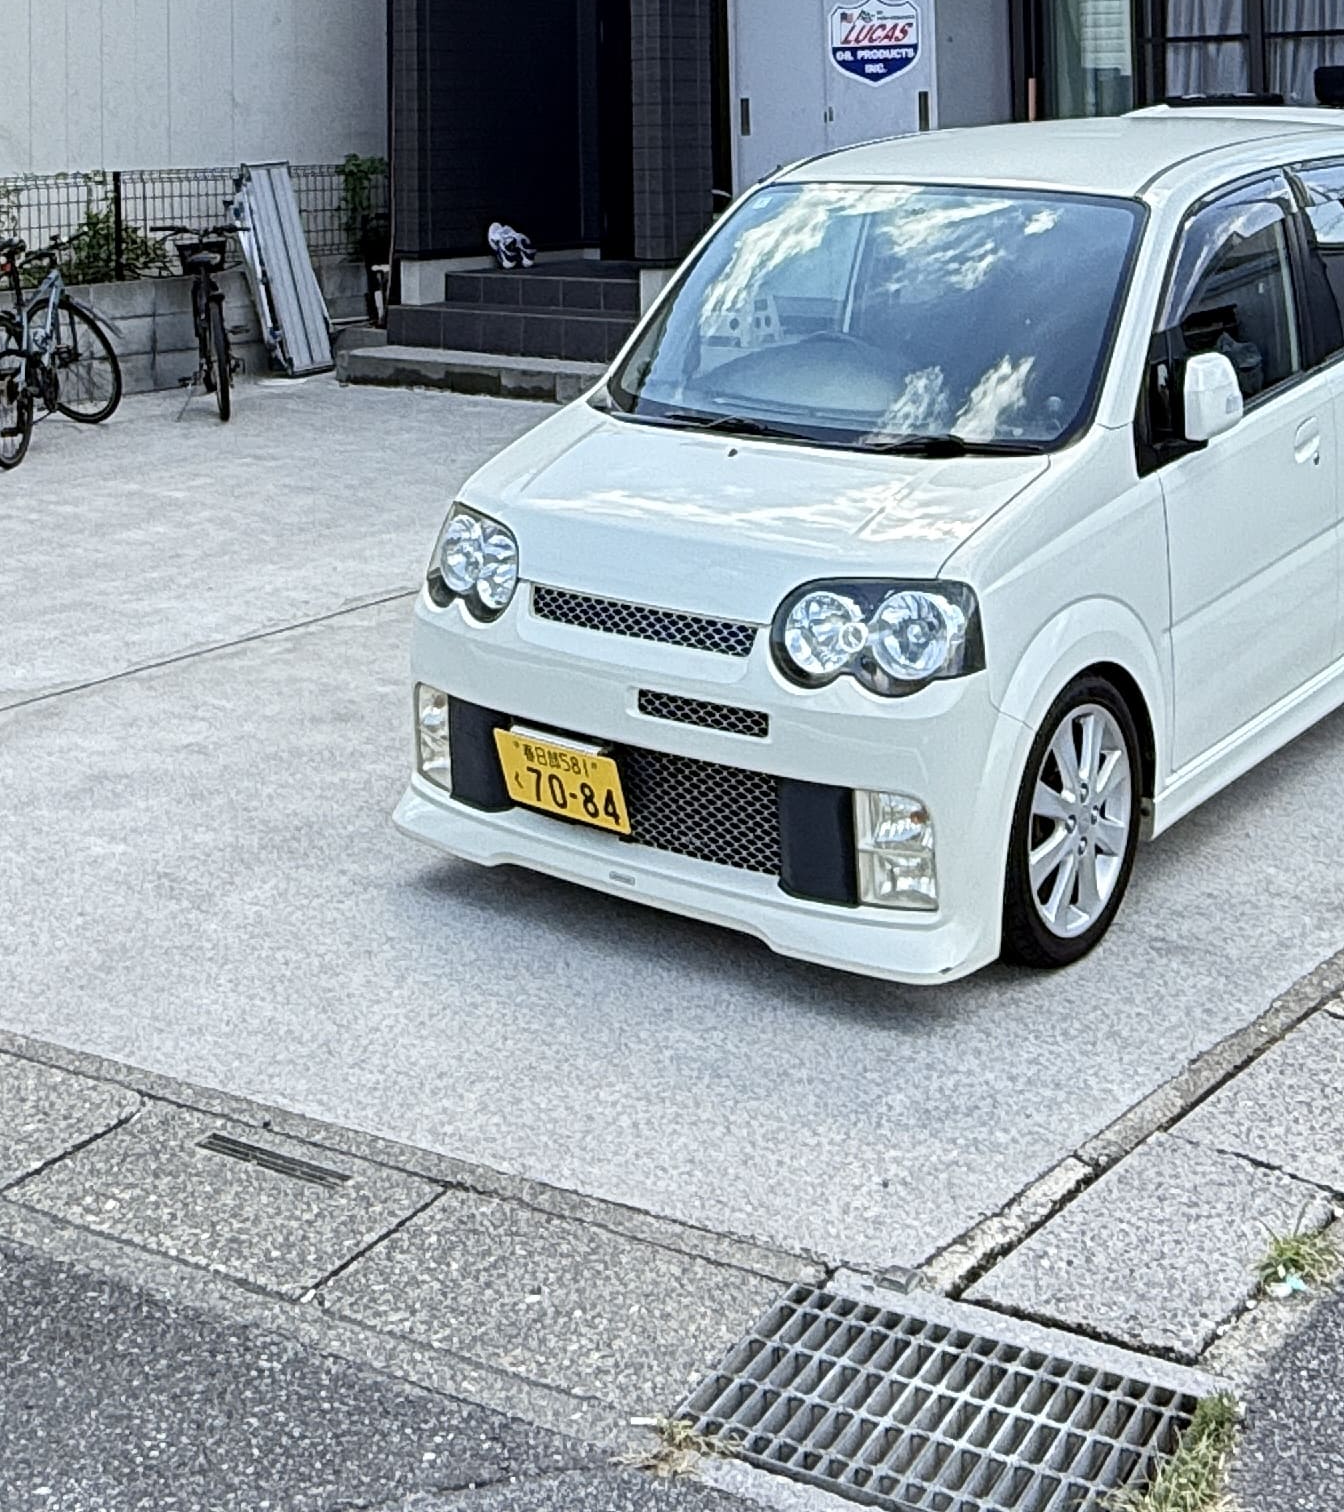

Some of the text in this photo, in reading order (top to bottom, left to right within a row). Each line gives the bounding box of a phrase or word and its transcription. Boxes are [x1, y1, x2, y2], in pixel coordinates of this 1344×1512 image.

[840, 22, 914, 45] LUCAS
[856, 47, 915, 60] PRODUCTS
[526, 765, 621, 826] 70-84
